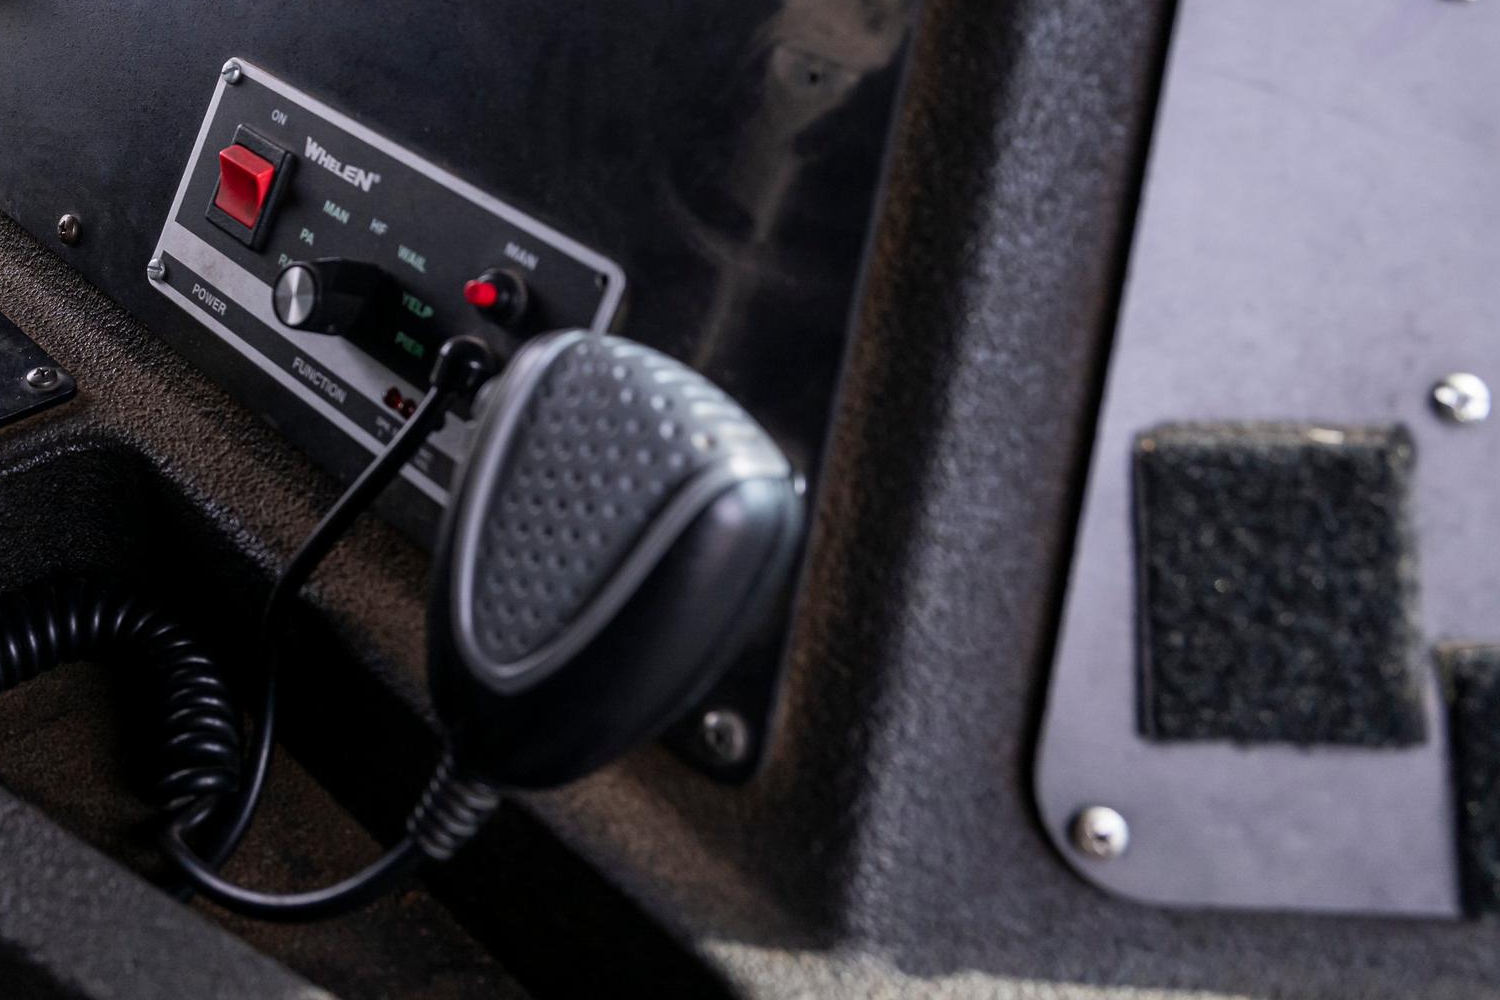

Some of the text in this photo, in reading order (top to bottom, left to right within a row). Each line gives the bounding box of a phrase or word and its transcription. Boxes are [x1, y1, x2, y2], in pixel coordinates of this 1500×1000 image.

[271, 109, 288, 126] ON
[322, 200, 350, 224] MAN
[300, 228, 315, 246] PA
[192, 283, 227, 315] POWER
[292, 356, 348, 404] FUNCTION
